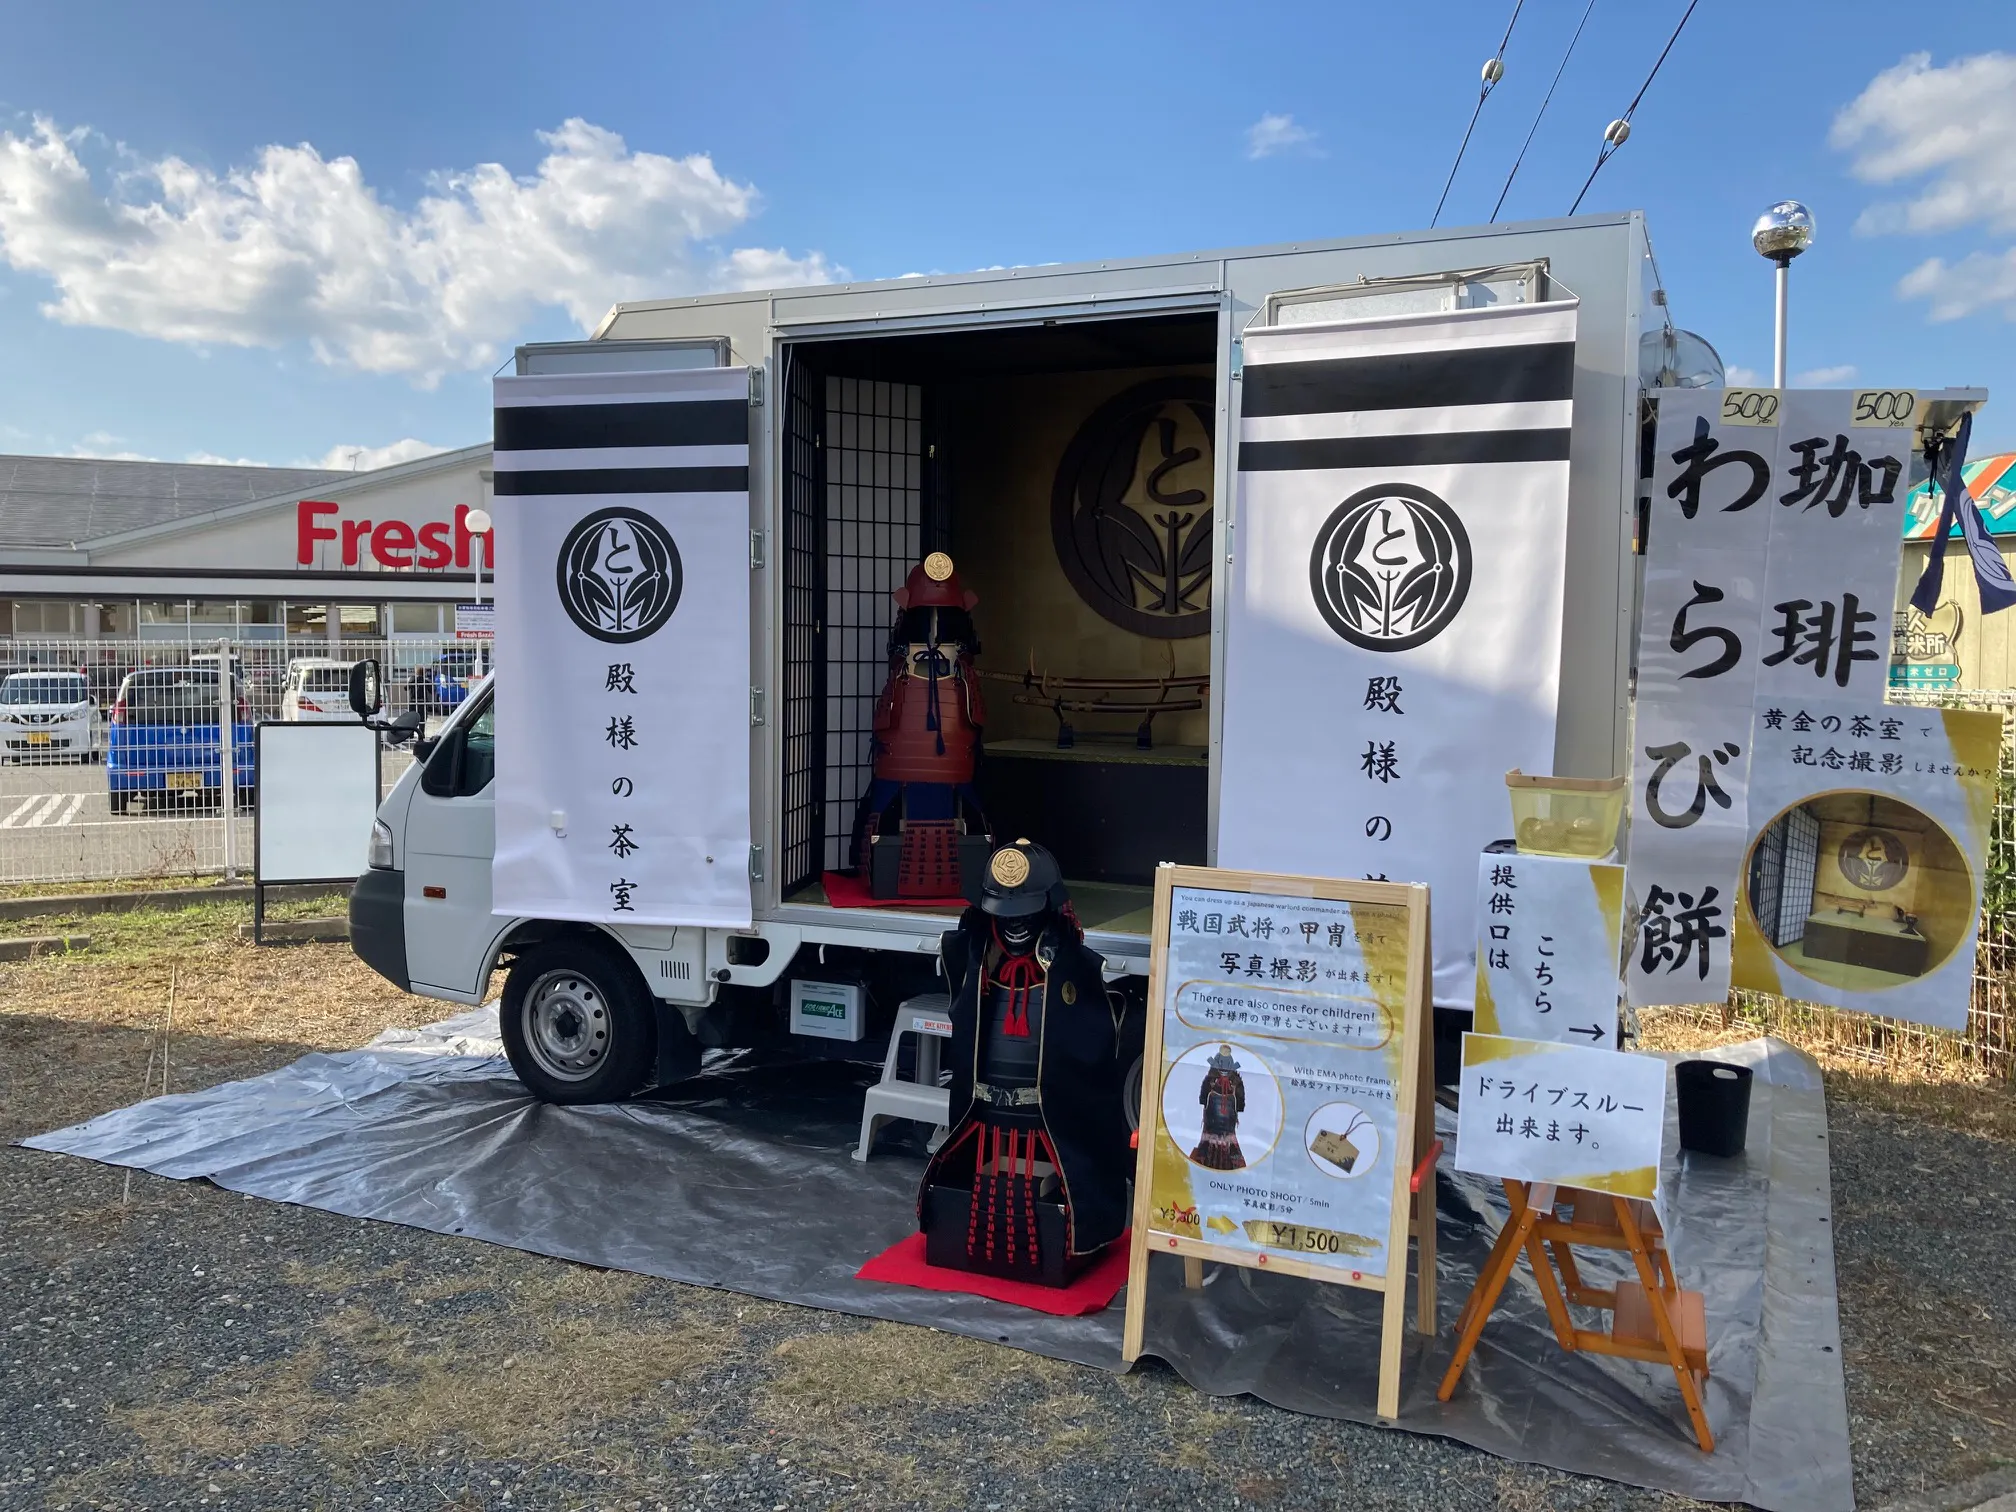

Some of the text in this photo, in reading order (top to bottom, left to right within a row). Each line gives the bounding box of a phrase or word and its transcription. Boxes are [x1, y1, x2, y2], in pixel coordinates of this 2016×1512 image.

[1724, 392, 1778, 418] 500
[1856, 391, 1915, 421] 500
[1888, 419, 1905, 428] yen
[297, 501, 494, 569] Fresh
[1762, 434, 1903, 687] 珈琲
[1640, 415, 1770, 981] わらび餅
[1762, 708, 1933, 741] 黄金の茶室で
[1360, 674, 1405, 882] 殿様の
[1790, 744, 1992, 780] 記念撮影しませんか?
[605, 662, 640, 912] 殿様の茶室
[1206, 896, 1223, 904] dress
[1301, 905, 1340, 914] commander
[1487, 864, 1518, 971] 提供口は
[1219, 951, 1393, 986] 写真撮影が出来ます！
[1534, 935, 1556, 1014] こちら
[1192, 991, 1376, 1022] There are also ones for children!
[1294, 1066, 1315, 1076] With
[1317, 1069, 1337, 1079] EMA
[1339, 1072, 1364, 1082] photo
[1478, 1075, 1645, 1114] ドライブスルー
[1495, 1114, 1600, 1150] 出来ます。
[1209, 1180, 1235, 1192] ONLY
[1236, 1185, 1268, 1198] PHOTO
